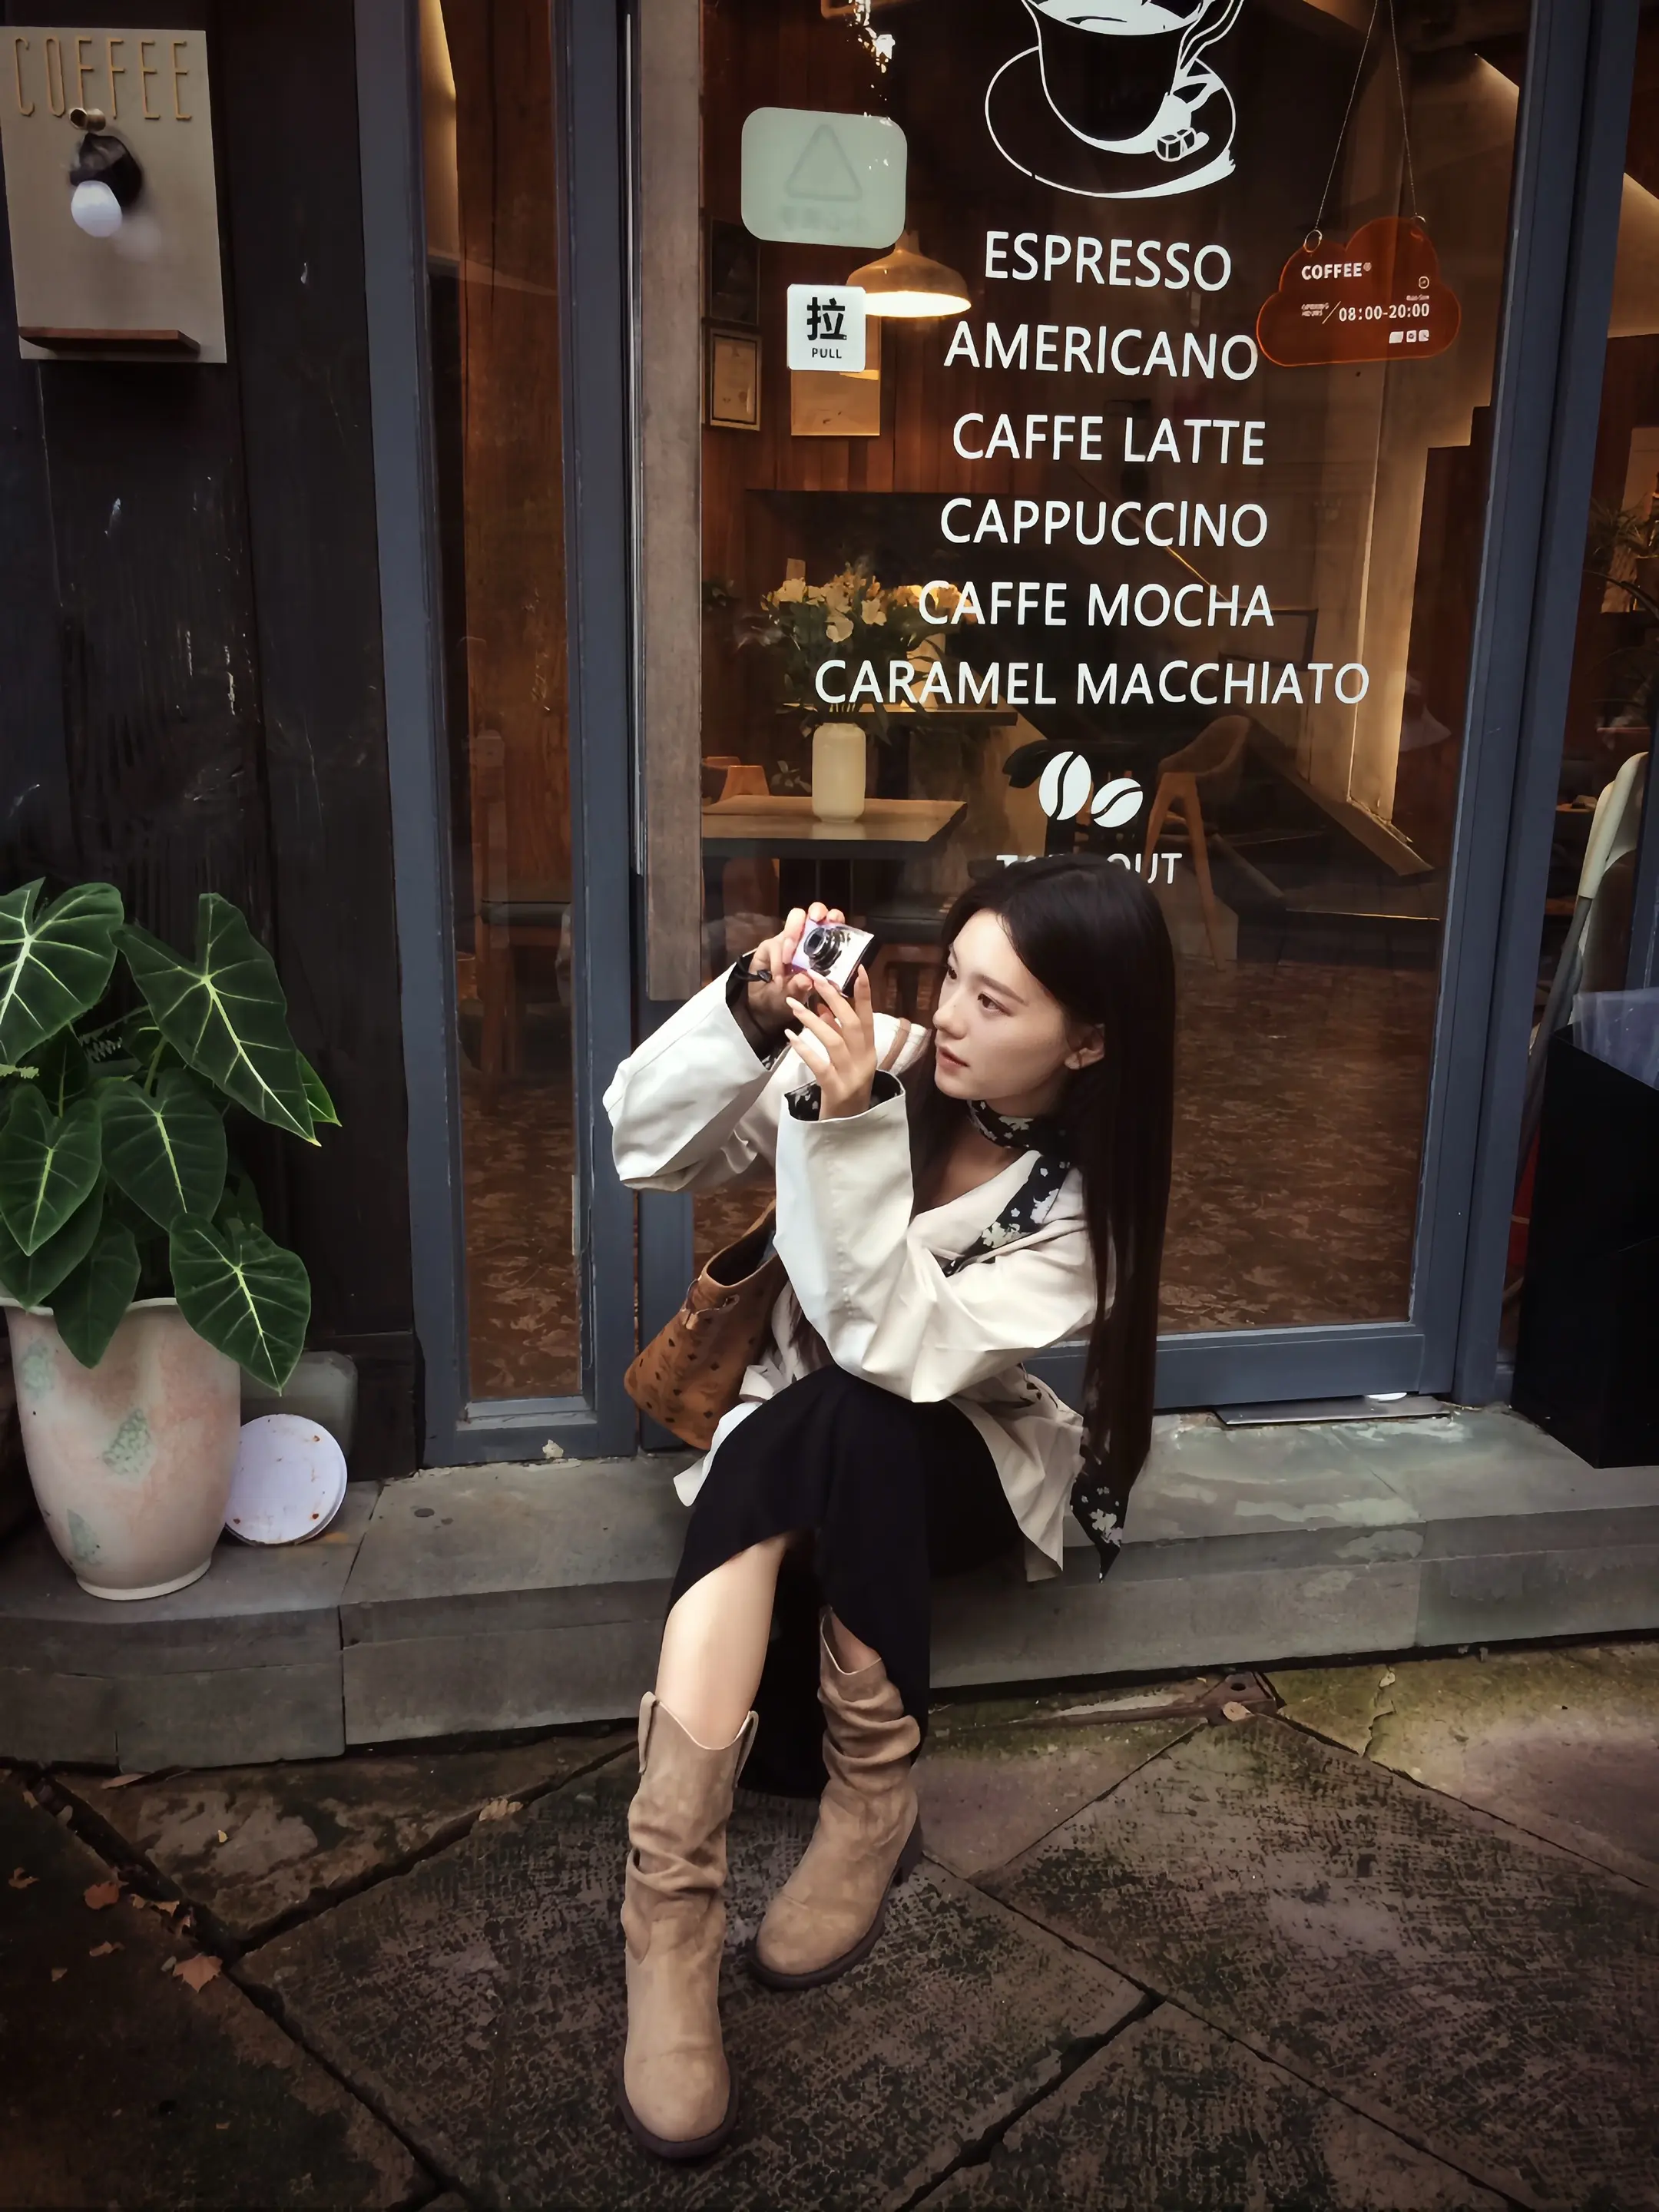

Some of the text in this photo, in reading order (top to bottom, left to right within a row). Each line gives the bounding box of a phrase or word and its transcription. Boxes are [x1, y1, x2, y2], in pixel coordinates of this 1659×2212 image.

[15, 36, 192, 121] COFFEE
[985, 230, 1231, 291] ESPRESSO
[806, 296, 847, 342] 拉
[1338, 303, 1430, 322] 08:00-20:00
[811, 347, 843, 359] PULL
[944, 320, 1258, 381] AMERICANO
[953, 412, 1266, 465] CAFFE LATTE
[941, 498, 1267, 547] CAPPUCCINO
[918, 580, 1274, 628] CAFFE MOCHA
[815, 659, 1369, 705] CARAMEL MACCHIATO
